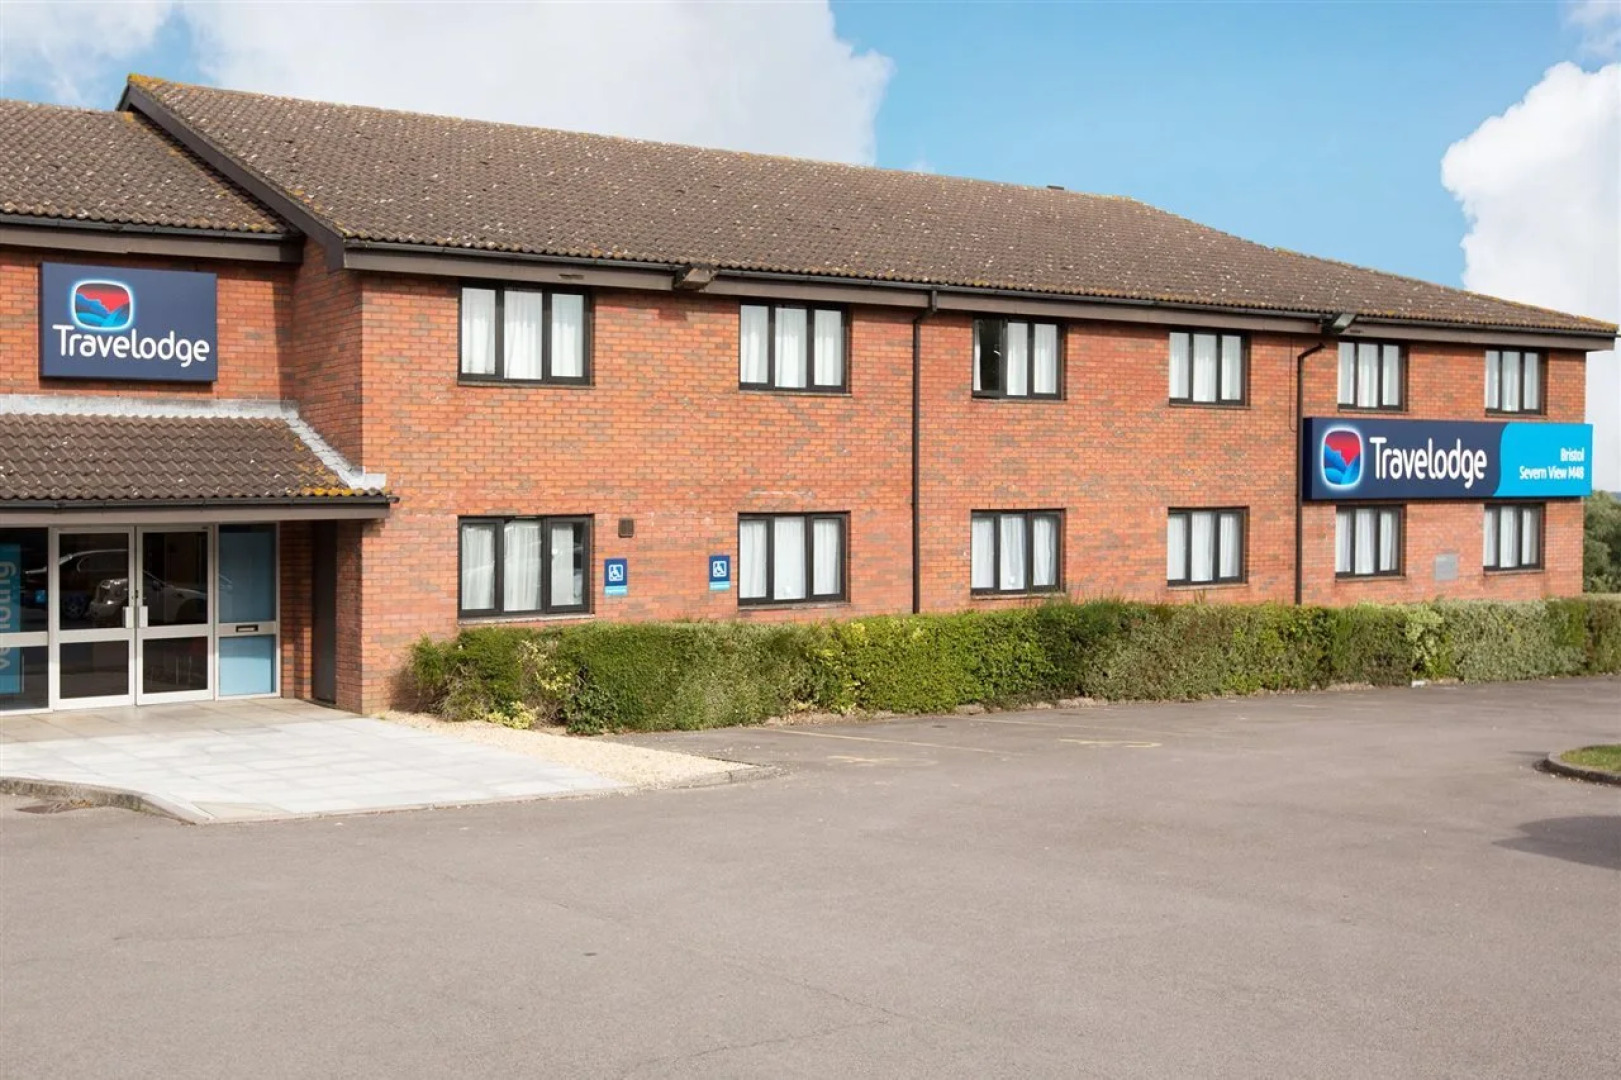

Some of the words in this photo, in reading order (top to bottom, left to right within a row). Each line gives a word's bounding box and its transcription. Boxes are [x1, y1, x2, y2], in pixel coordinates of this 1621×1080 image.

[52, 324, 210, 367] Travelodge
[1369, 437, 1487, 489] Travelodge
[1560, 447, 1584, 461] Bristol
[1519, 466, 1547, 480] Severn
[1548, 466, 1567, 480] View
